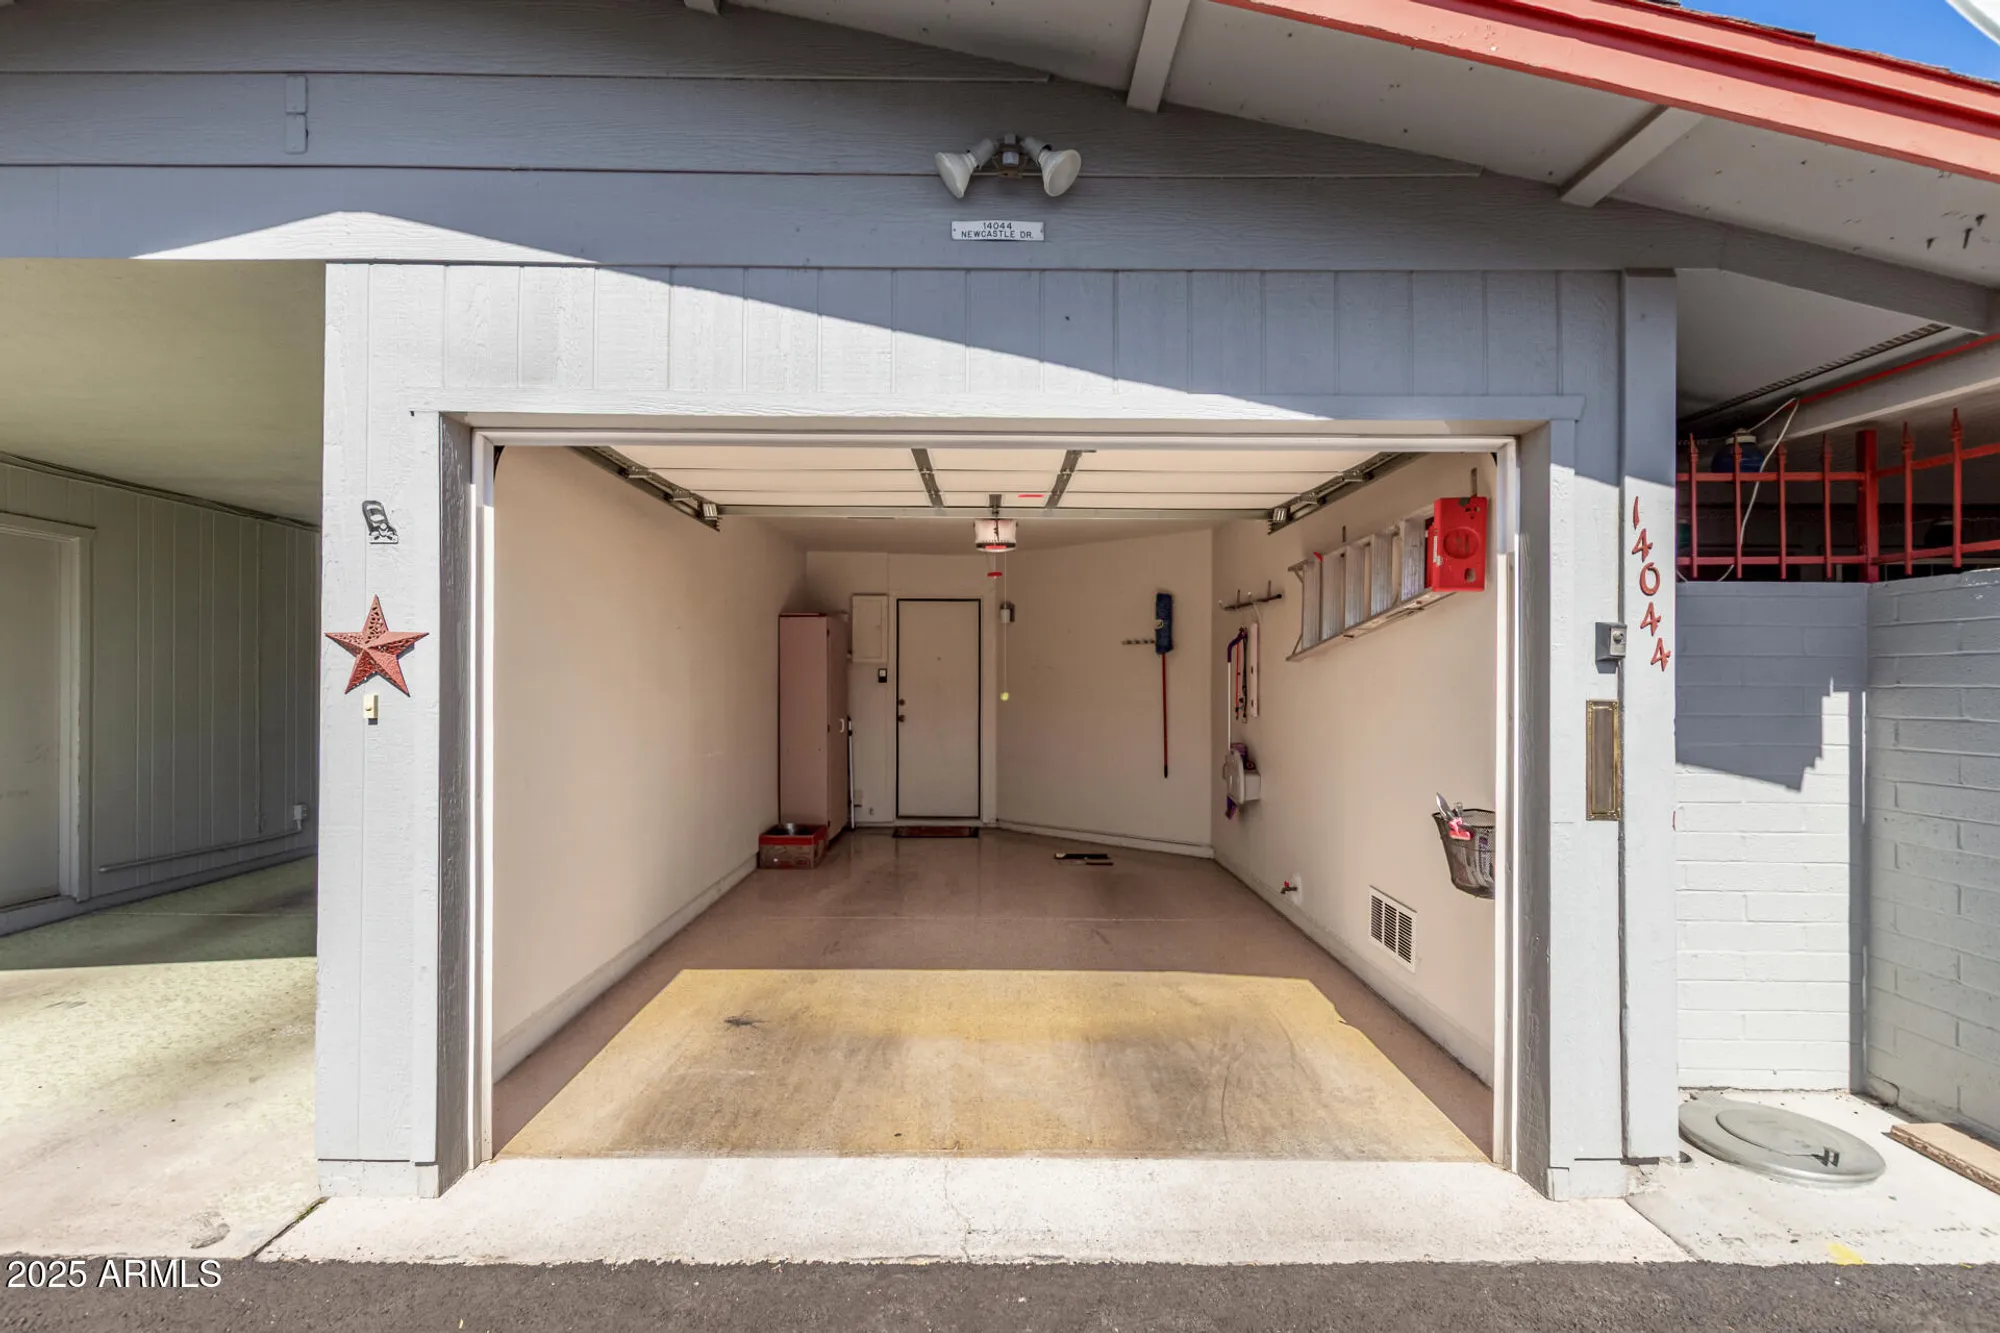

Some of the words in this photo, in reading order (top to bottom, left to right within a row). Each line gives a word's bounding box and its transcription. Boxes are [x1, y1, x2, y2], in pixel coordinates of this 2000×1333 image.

[983, 222, 1012, 230] 14044
[961, 230, 1015, 238] NEWCASTLE
[1019, 230, 1034, 239] DR.
[1631, 495, 1671, 672] 14044
